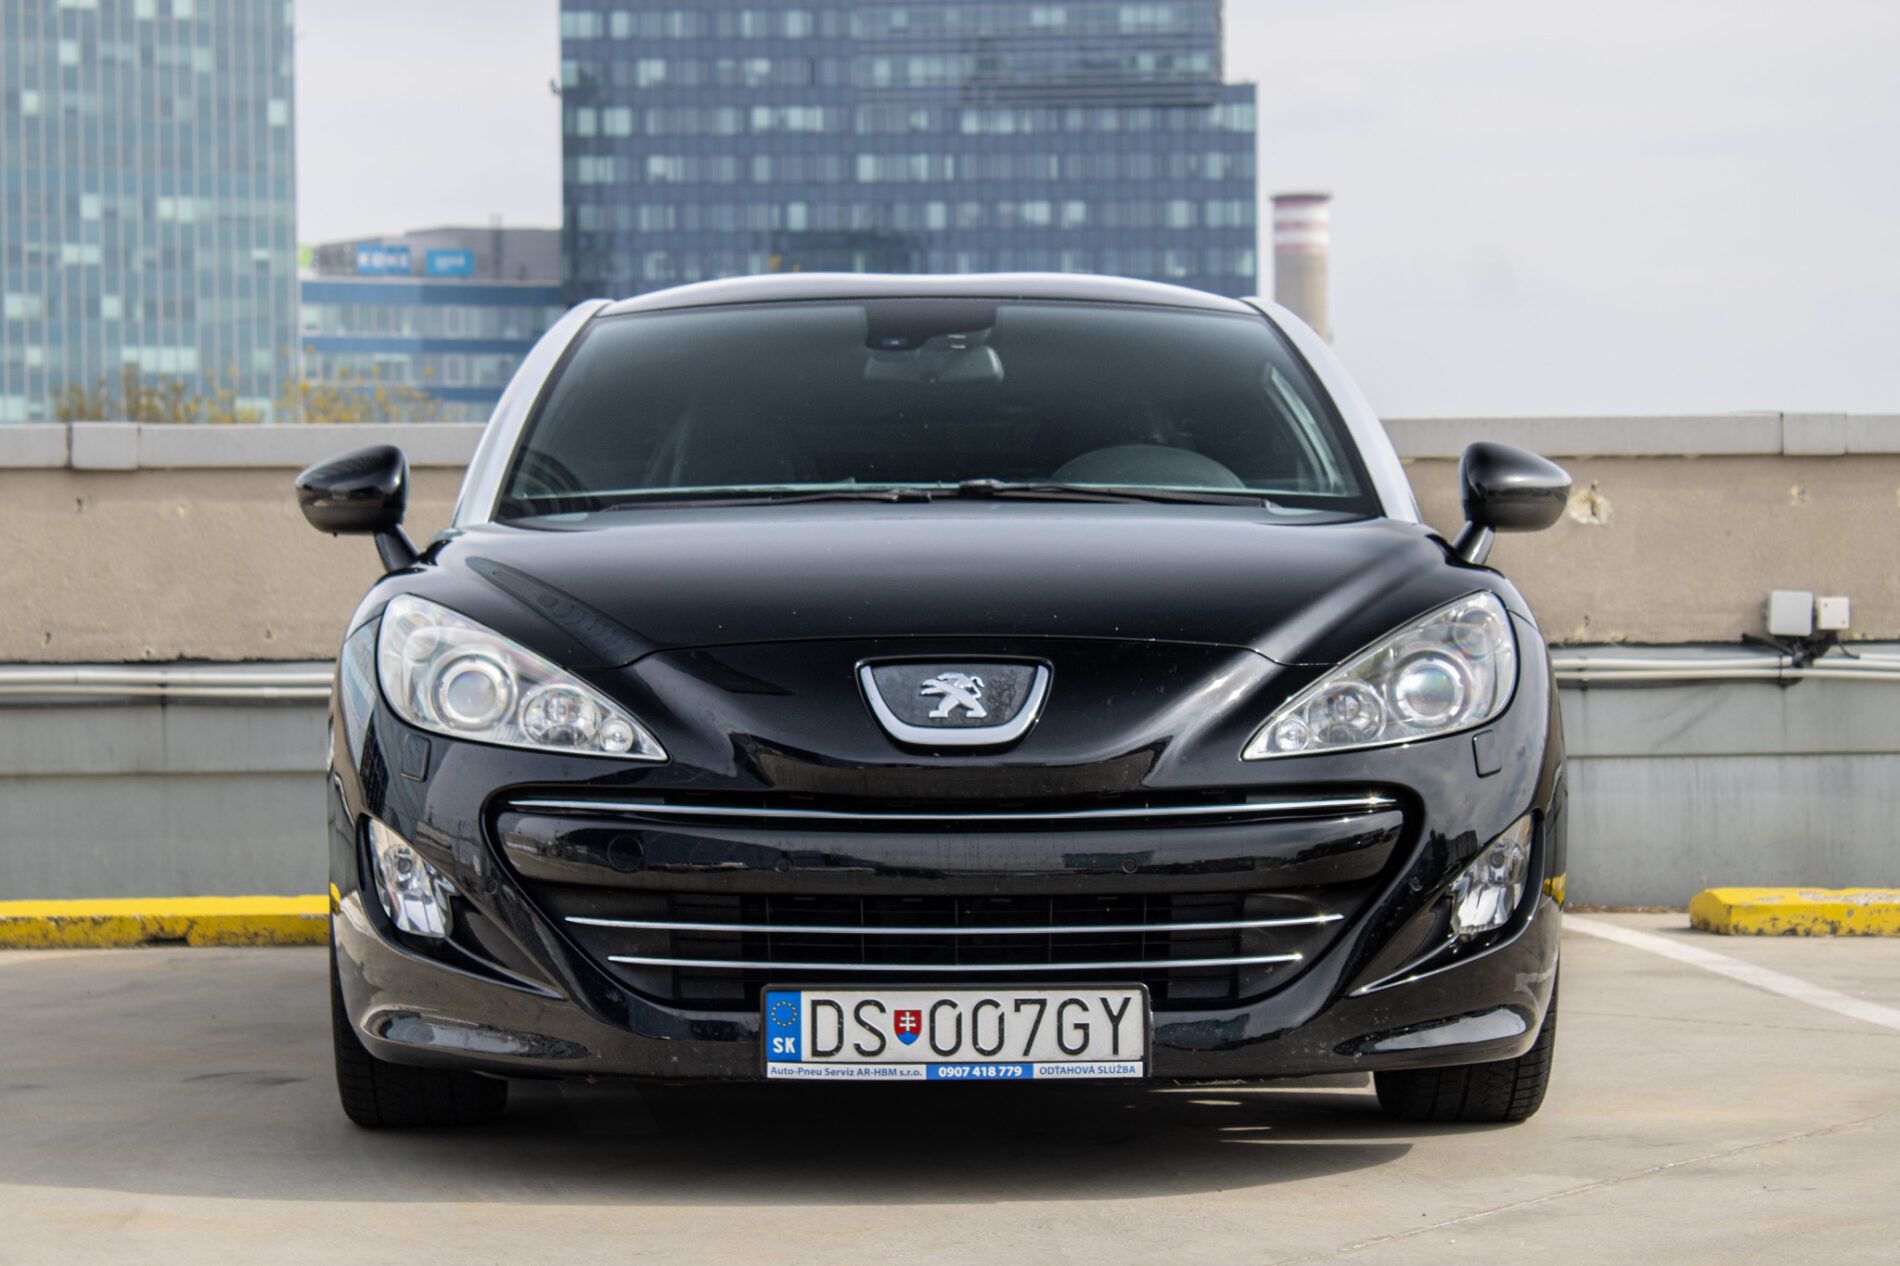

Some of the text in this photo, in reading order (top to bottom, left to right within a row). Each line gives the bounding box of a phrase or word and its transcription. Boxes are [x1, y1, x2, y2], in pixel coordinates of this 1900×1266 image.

[810, 997, 1132, 1057] DS 007GY
[772, 1038, 796, 1054] SK
[770, 1066, 822, 1076] Auto-Pneu
[825, 1067, 854, 1077] Serviz
[856, 1068, 898, 1077] AR-HBM
[938, 1065, 1023, 1078] 0907 418 779
[1097, 1063, 1136, 1075] SLUŽBA
